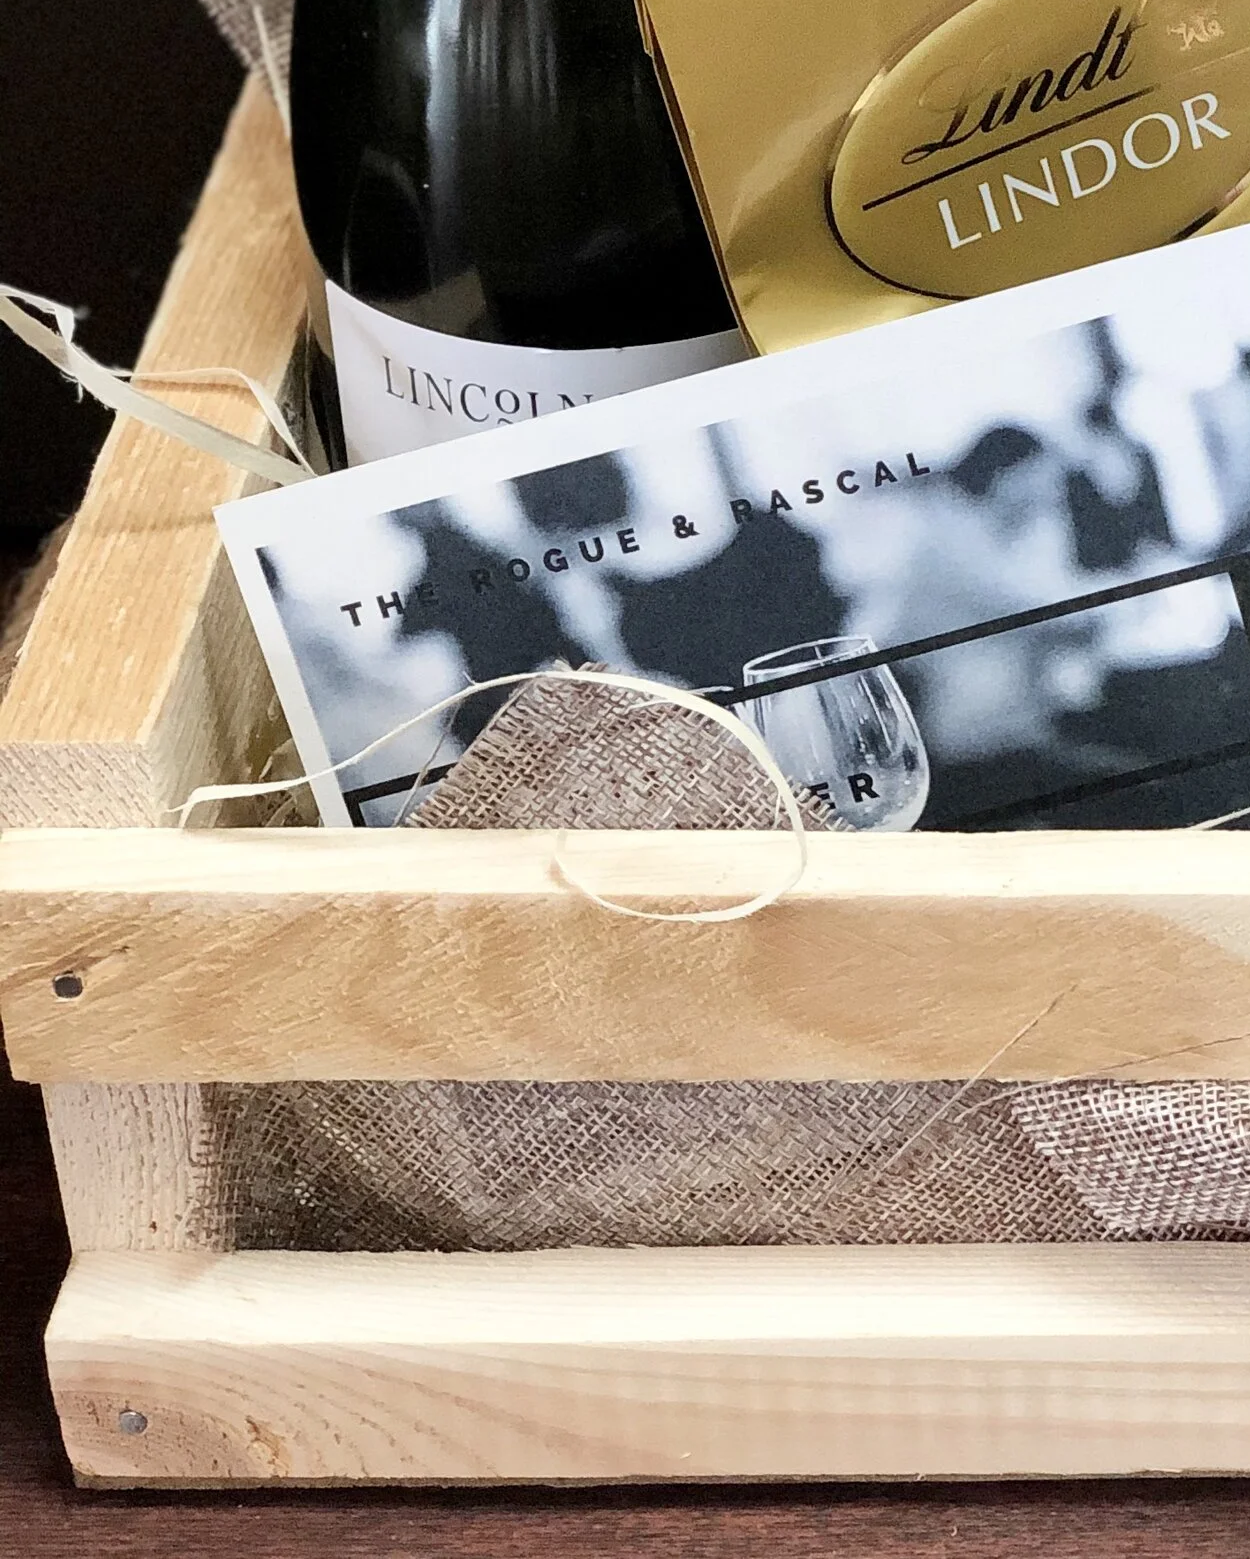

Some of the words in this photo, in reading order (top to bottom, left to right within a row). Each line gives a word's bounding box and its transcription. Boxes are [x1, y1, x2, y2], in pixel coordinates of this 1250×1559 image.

[938, 92, 1232, 250] LINDOR
[340, 582, 440, 628] THE
[468, 527, 641, 594] ROGUE
[672, 513, 700, 539] &
[729, 452, 931, 525] RASCAL
